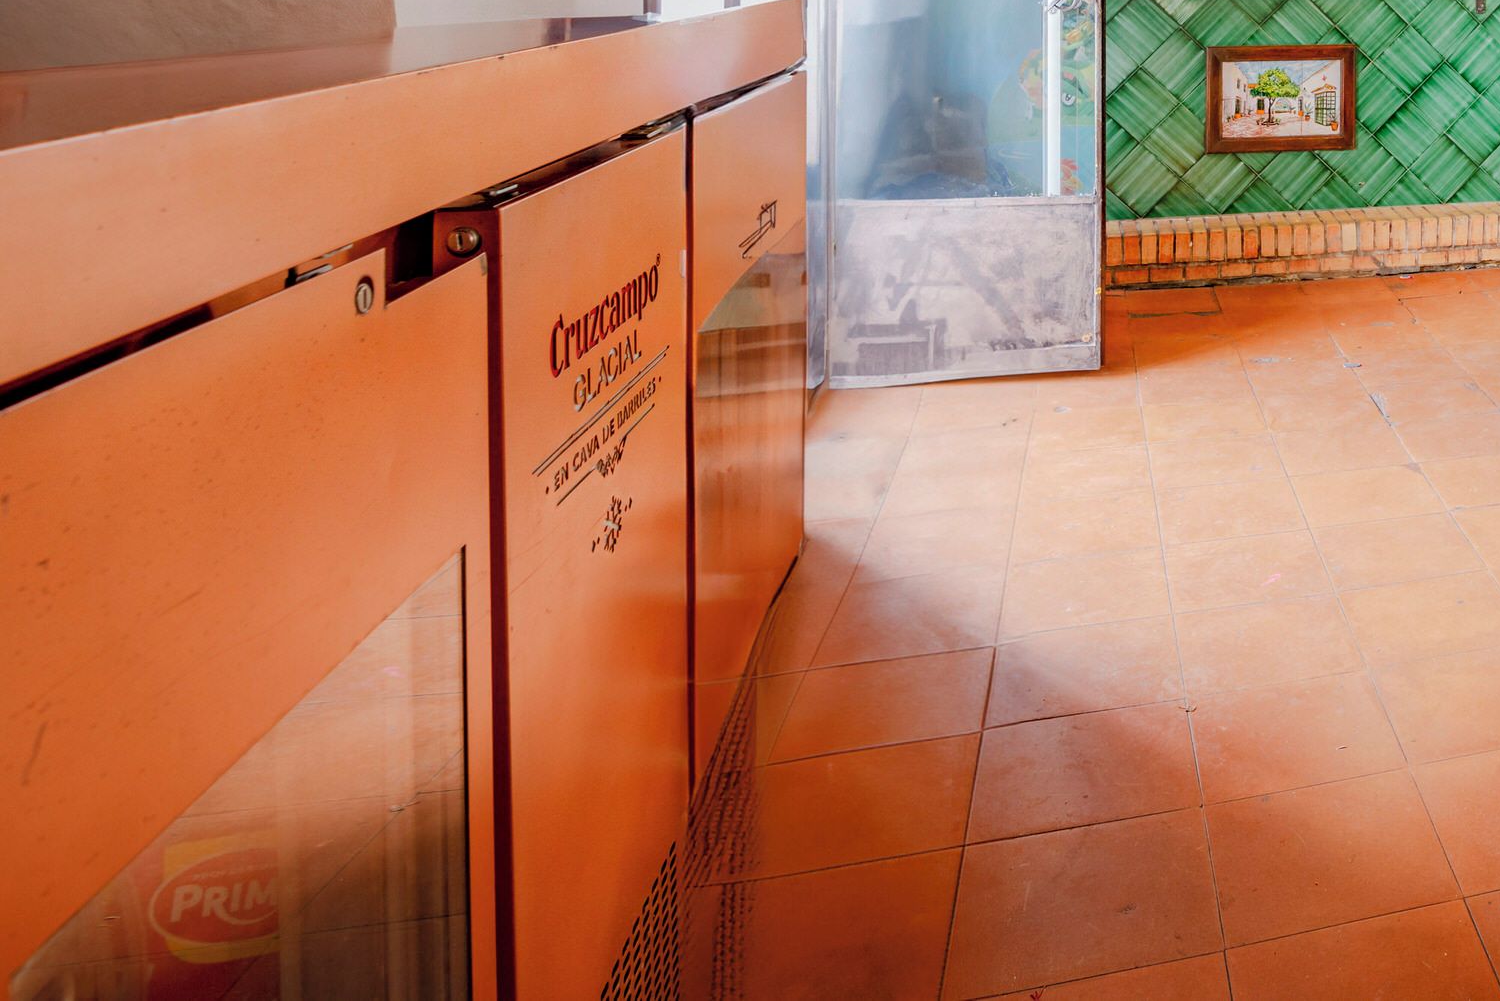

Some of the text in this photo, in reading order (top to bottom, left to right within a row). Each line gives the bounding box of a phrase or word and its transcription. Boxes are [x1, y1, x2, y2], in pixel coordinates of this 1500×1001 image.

[549, 265, 659, 379] Cruzcampo
[573, 329, 642, 413] GLACIAL
[553, 379, 657, 493] EN CAVA DE BARRILES
[170, 878, 277, 924] PRIM
